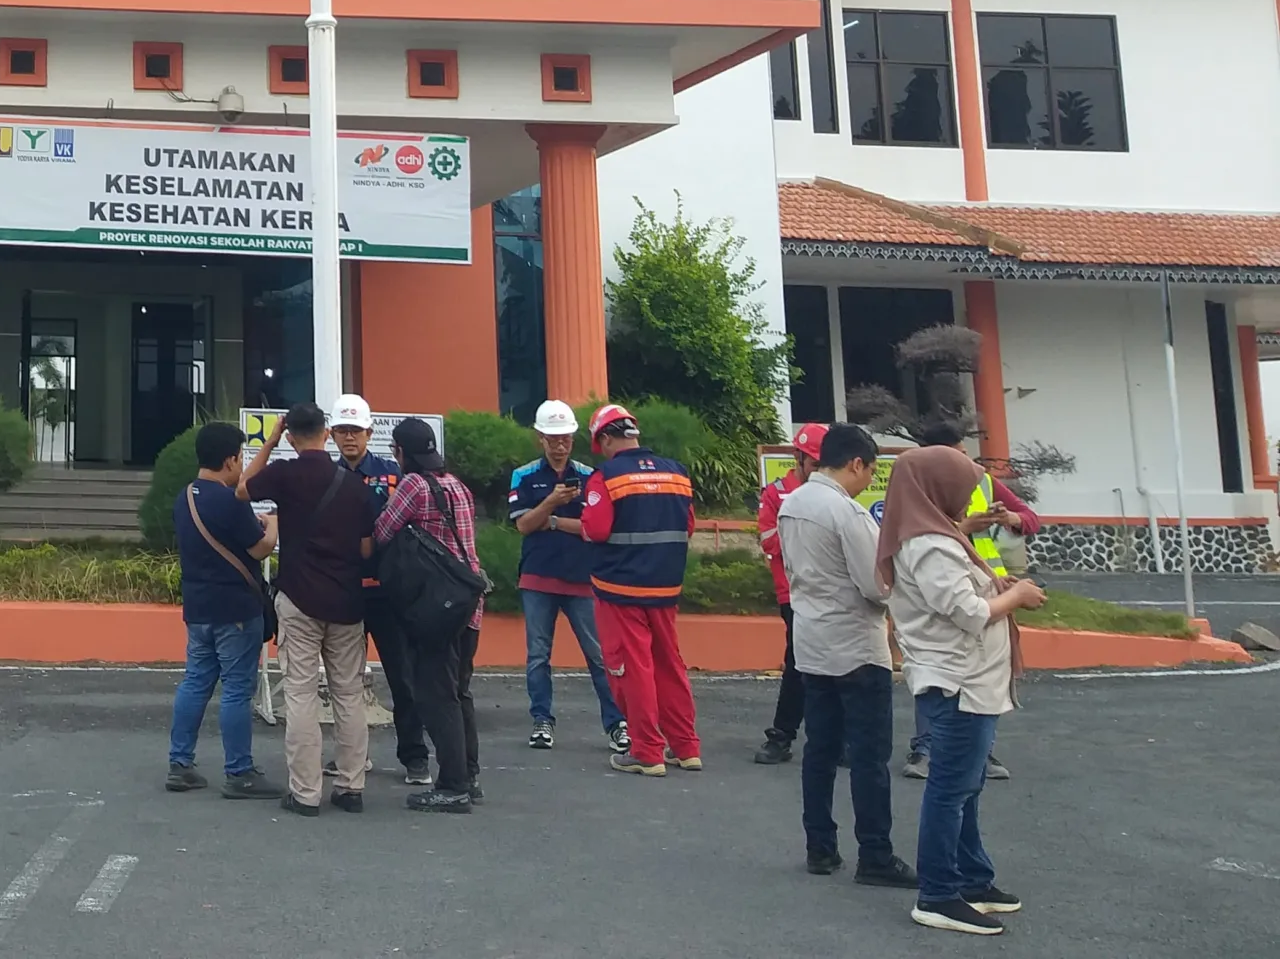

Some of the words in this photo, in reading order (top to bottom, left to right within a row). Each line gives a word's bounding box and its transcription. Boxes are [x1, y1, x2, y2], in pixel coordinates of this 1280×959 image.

[55, 143, 72, 156] VK
[143, 147, 296, 174] UTAMAKAN
[105, 173, 304, 202] KESELAMATAN
[352, 179, 381, 187] NINDYA
[88, 201, 251, 228] KESEHATAN
[261, 208, 351, 233] KERA
[99, 231, 146, 243] PROYEK
[148, 233, 208, 246] RENOVASI
[210, 236, 265, 248] SEKOLAH
[266, 238, 313, 250] RAKYAT
